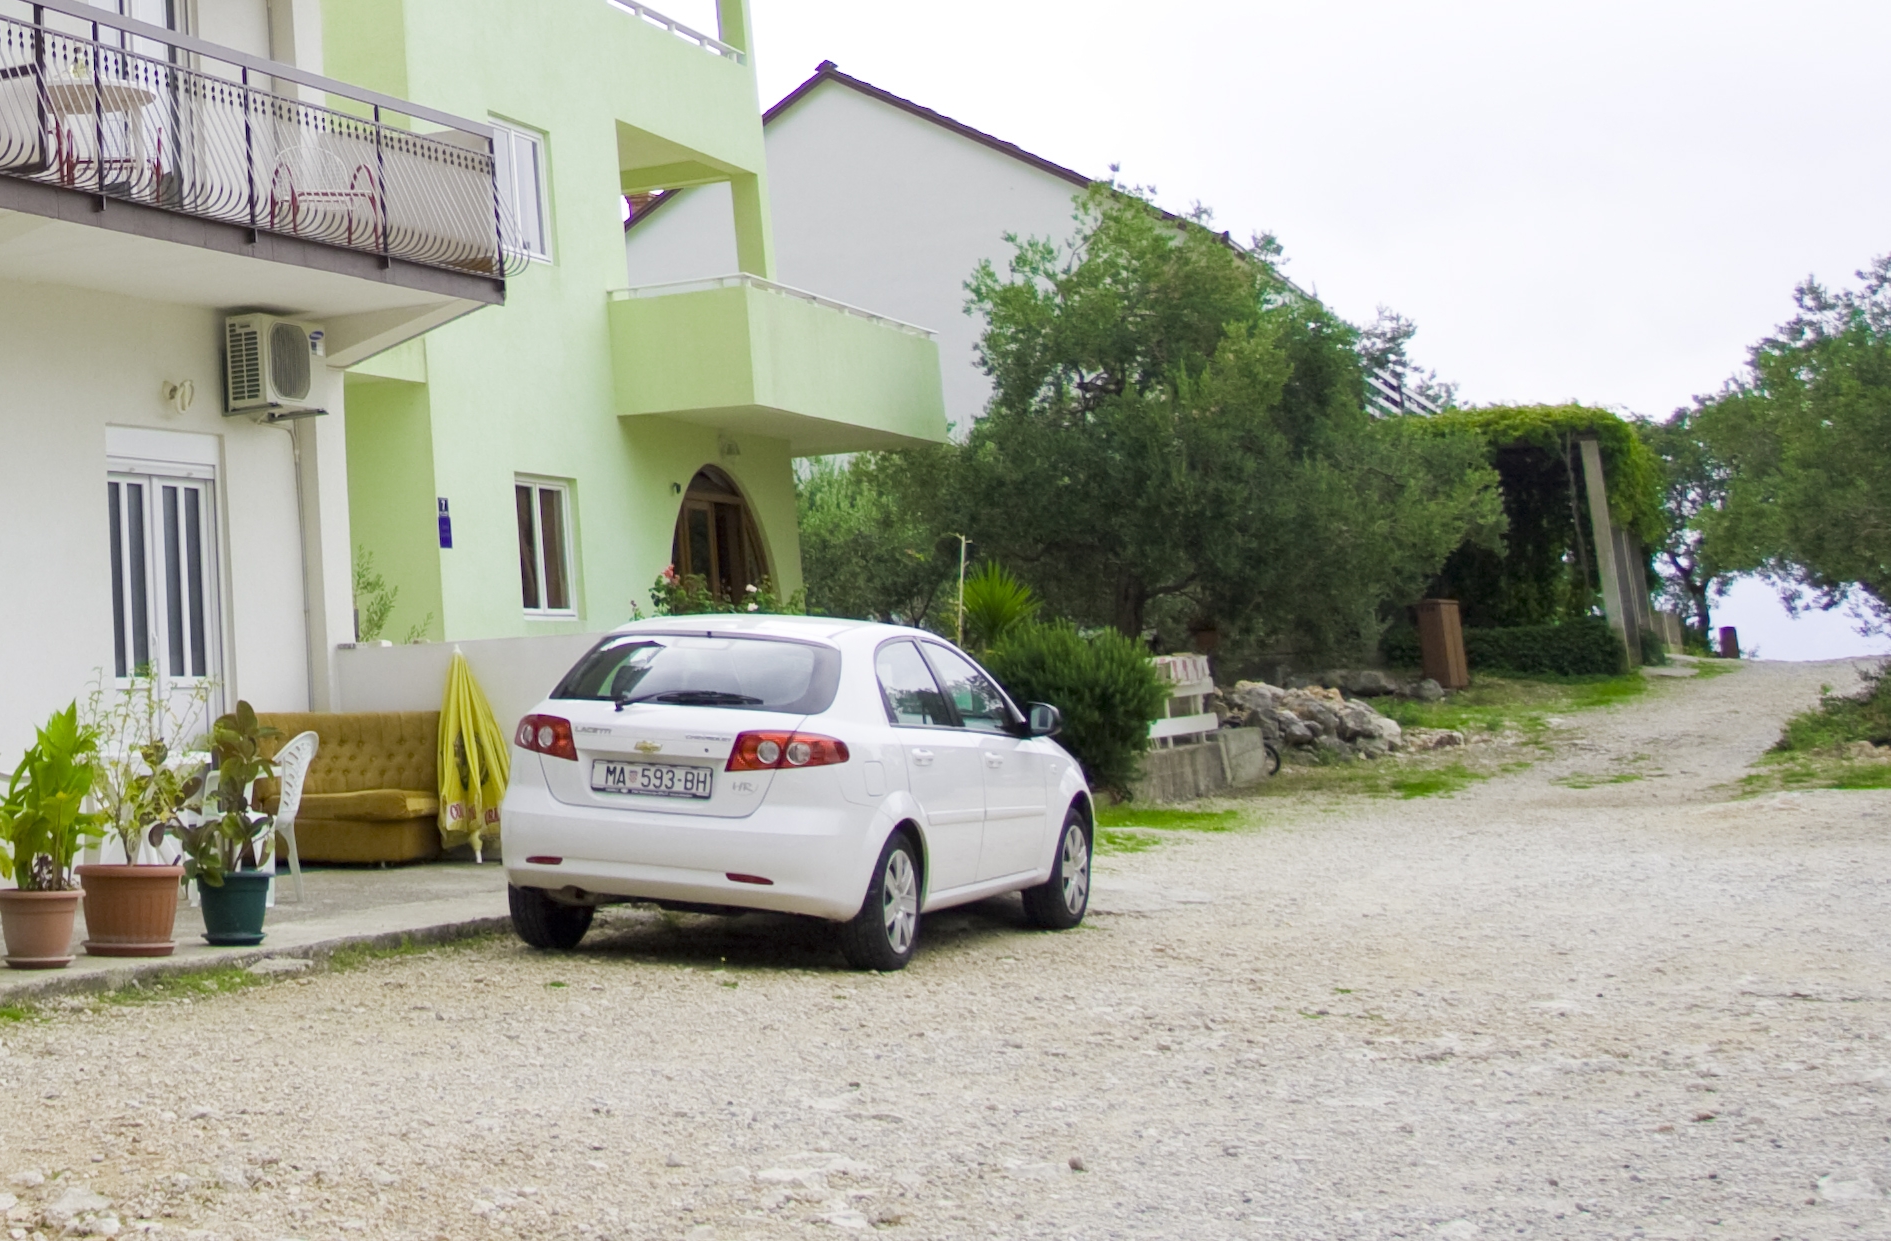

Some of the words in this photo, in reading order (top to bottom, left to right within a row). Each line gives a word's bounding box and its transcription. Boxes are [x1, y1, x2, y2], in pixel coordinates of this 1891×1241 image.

[574, 726, 612, 735] LACETTI
[605, 765, 626, 786] MA
[641, 768, 708, 792] 593-BH
